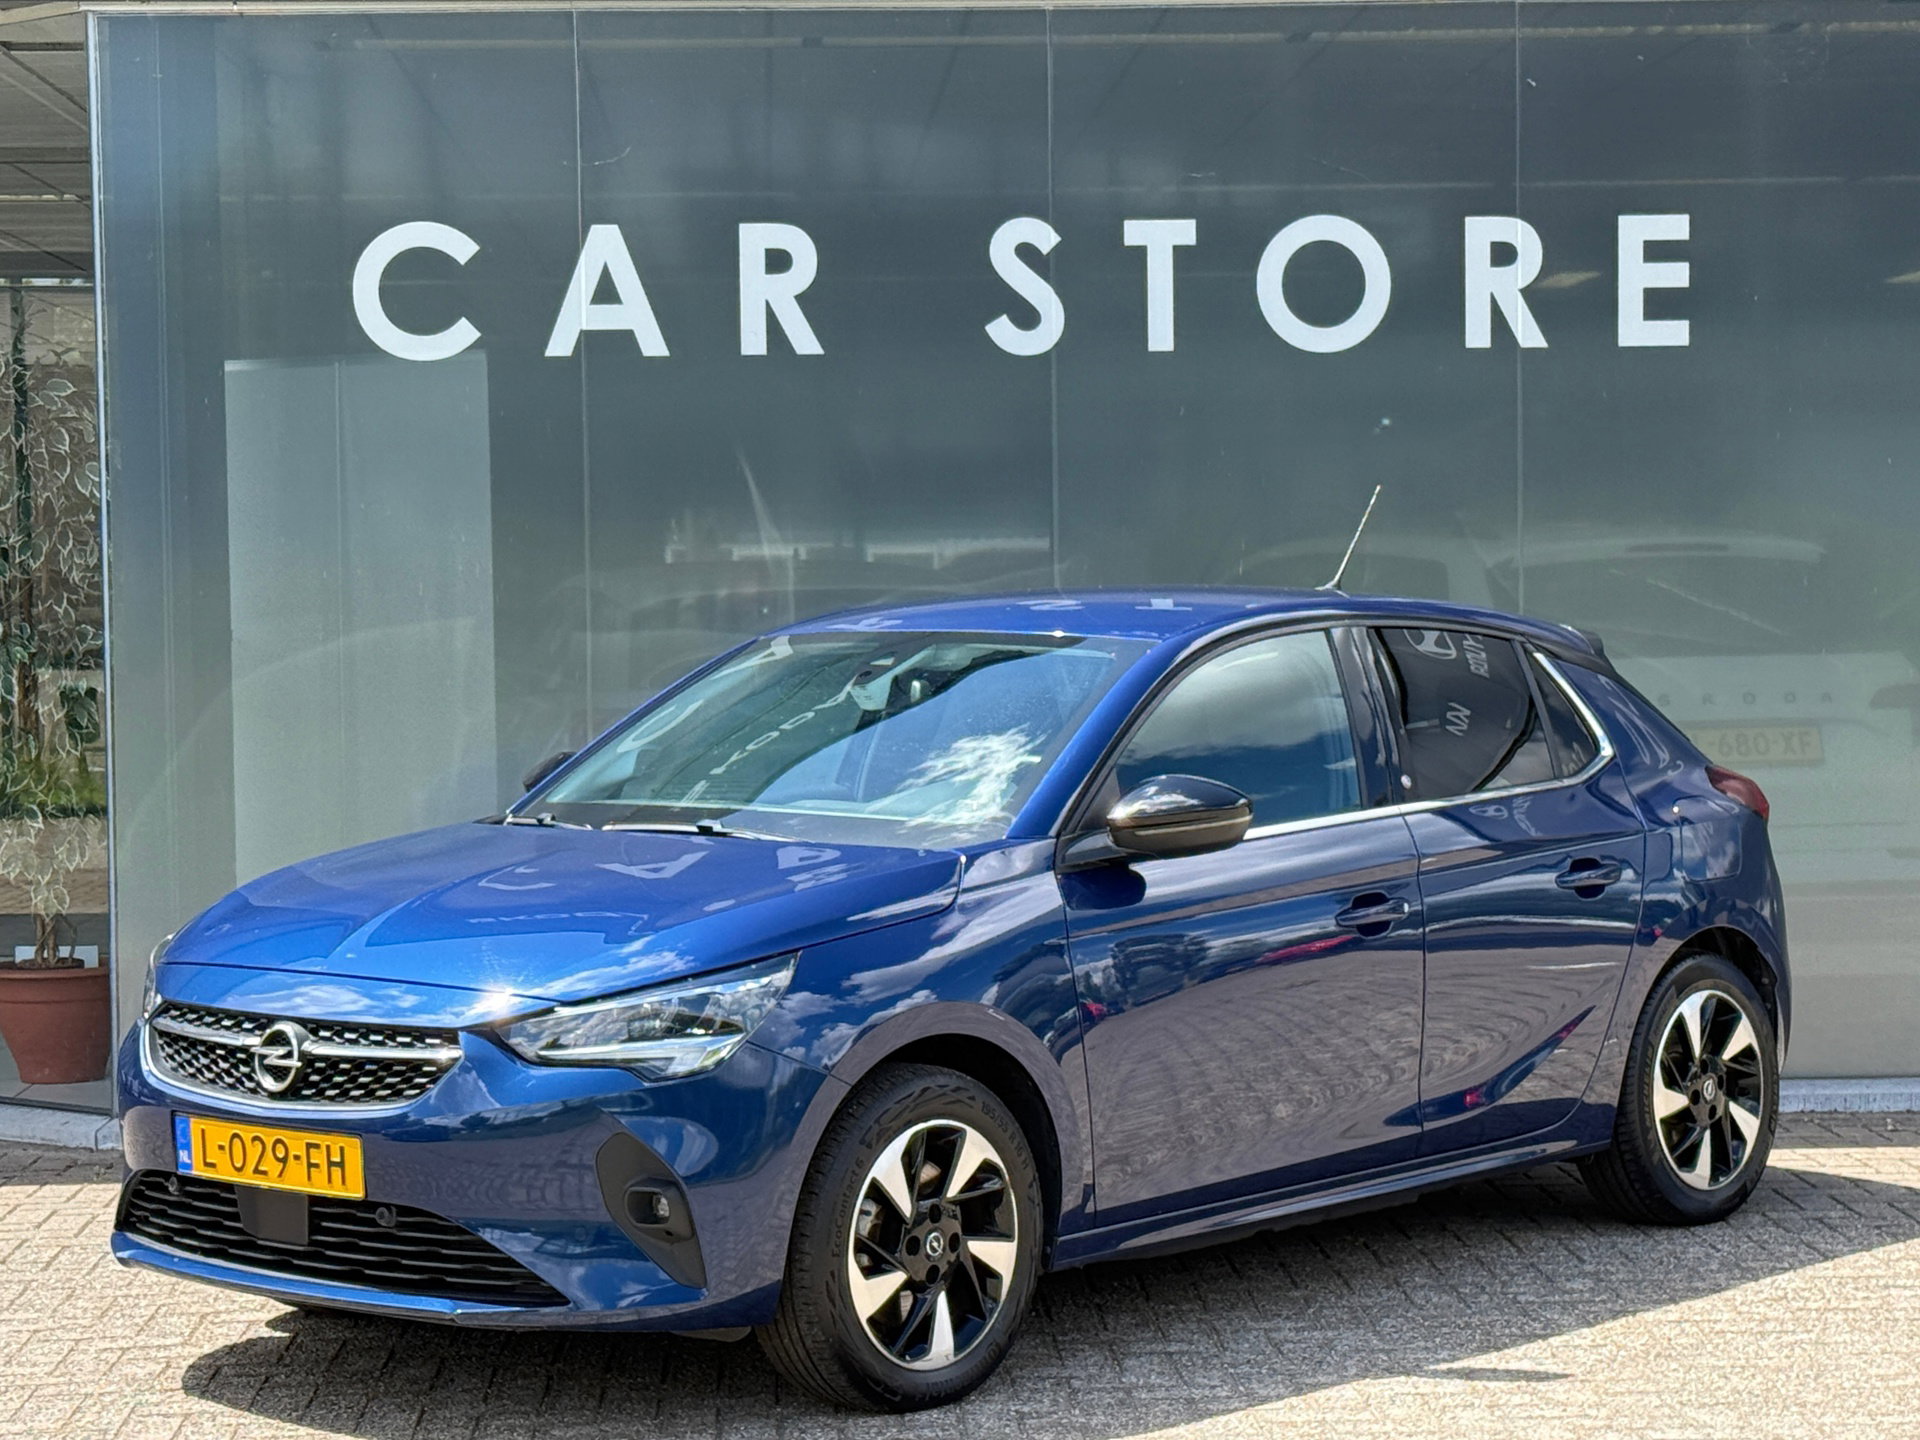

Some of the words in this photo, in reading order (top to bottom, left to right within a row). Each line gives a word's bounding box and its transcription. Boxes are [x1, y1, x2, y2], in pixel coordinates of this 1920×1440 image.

[352, 221, 825, 361] CAR
[984, 214, 1690, 356] STORE
[1691, 731, 1812, 757] -680-XF
[179, 1150, 191, 1163] NL
[201, 1127, 346, 1186] L-029-FH
